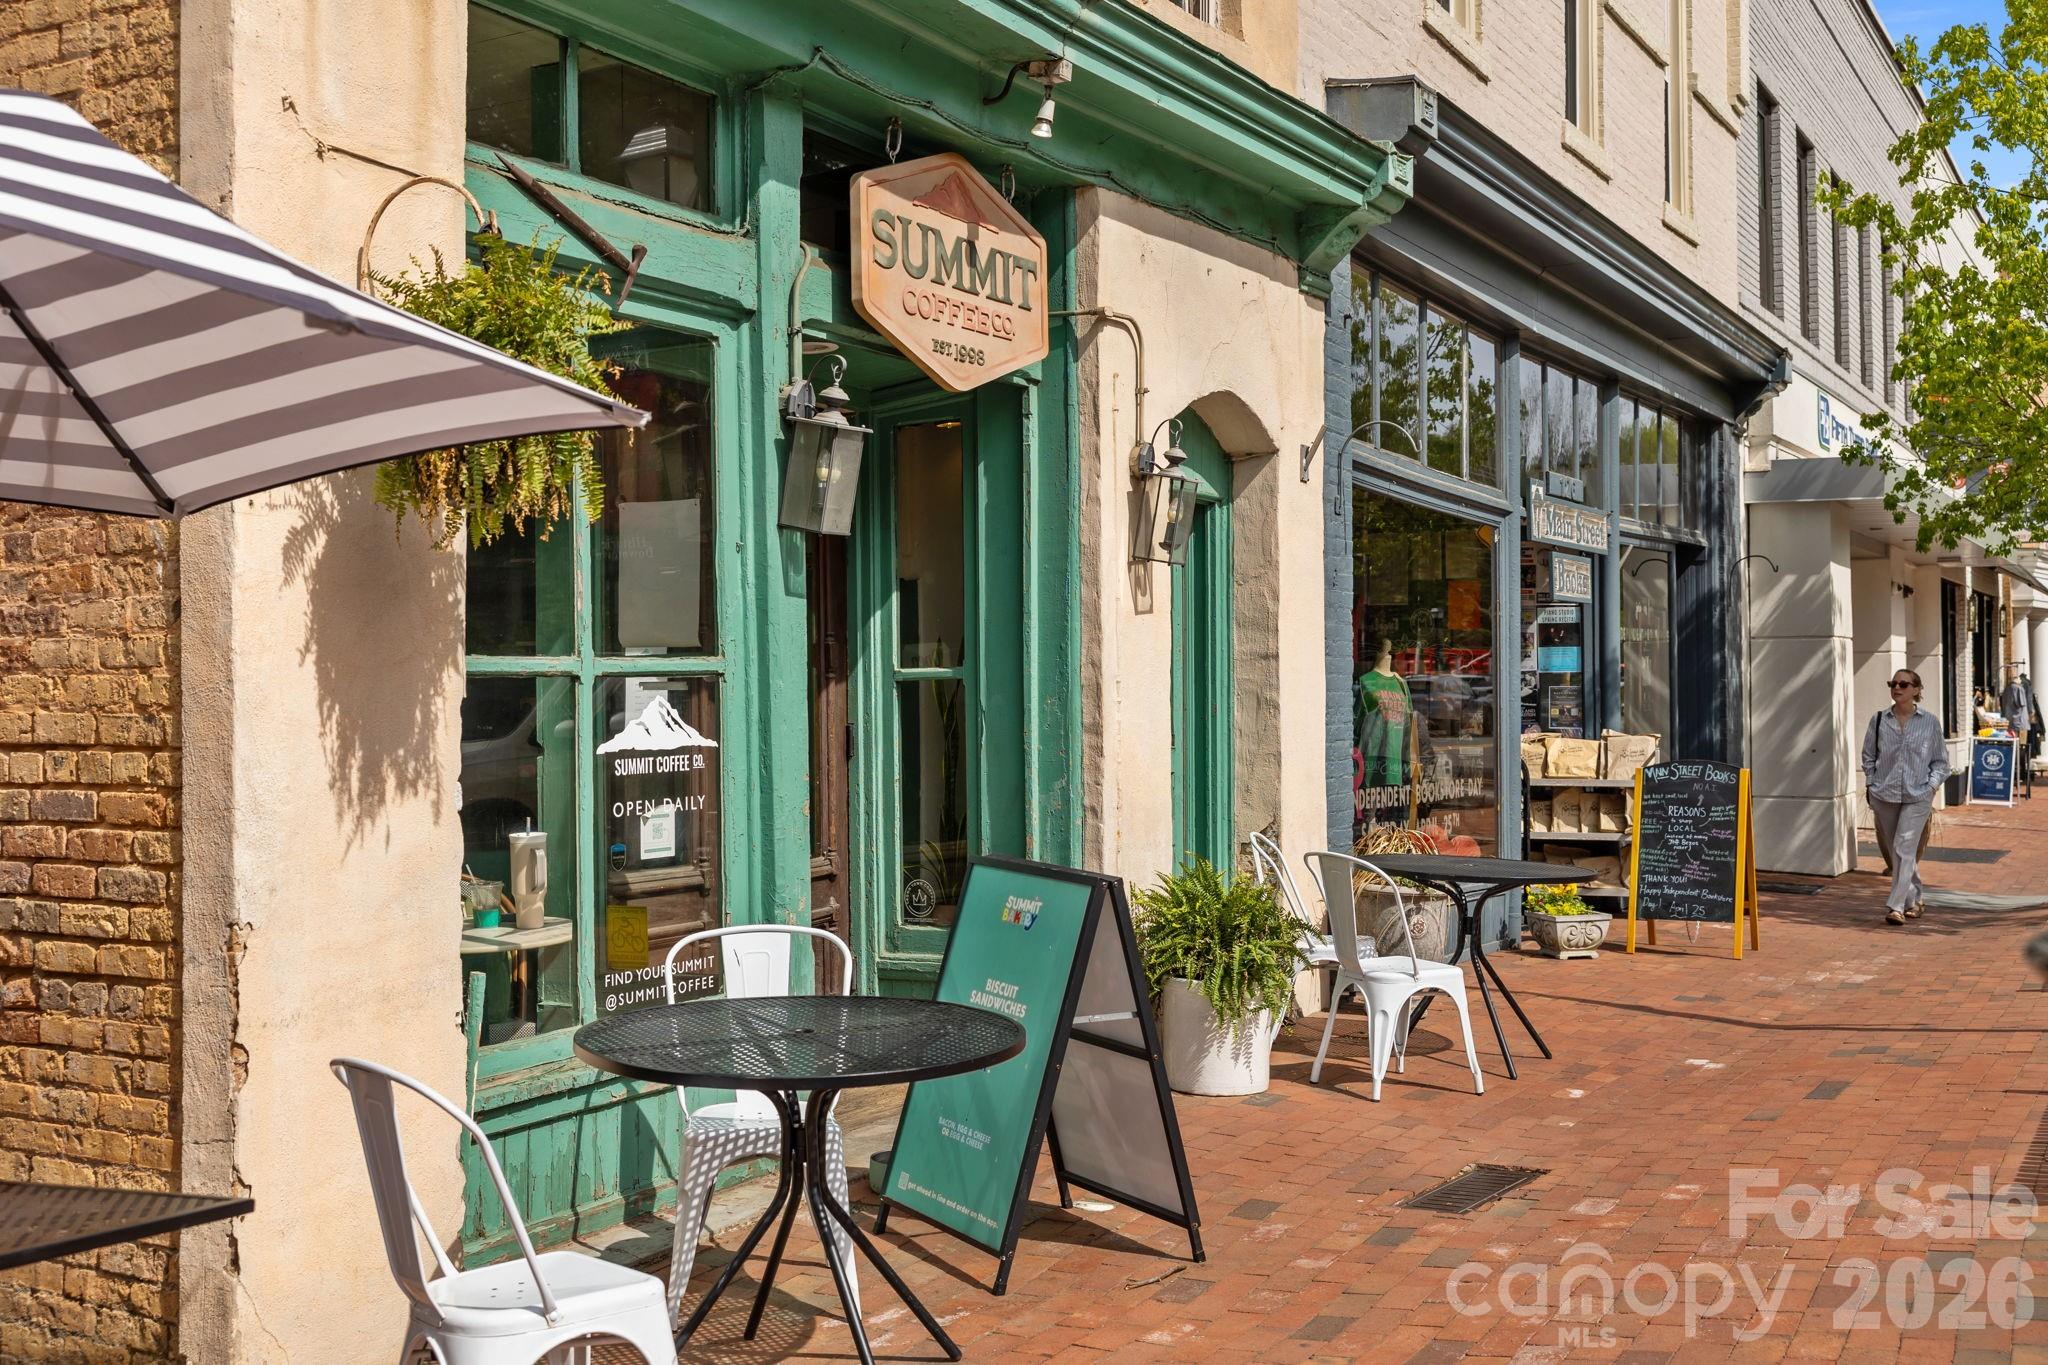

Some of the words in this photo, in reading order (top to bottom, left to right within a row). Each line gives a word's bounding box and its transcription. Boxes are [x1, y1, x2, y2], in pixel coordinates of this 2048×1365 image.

[872, 208, 1037, 312] SUMMIT
[902, 285, 990, 336] COFFEE
[991, 312, 1015, 341] CO.
[954, 345, 985, 367] 1998
[1545, 504, 1573, 540] Main
[1574, 511, 1605, 547] Street
[1554, 558, 1588, 595] Books
[614, 757, 654, 776] SUMMIT
[656, 755, 690, 773] COFFEE
[692, 754, 705, 768] CO.
[1644, 767, 1670, 783] MAIN
[1670, 763, 1703, 780] STREET
[1704, 764, 1737, 784] BOOKS
[1354, 784, 1411, 811] NDEPENDENT
[1416, 778, 1465, 804] BOOKSTORE
[1468, 777, 1483, 796] DAY
[613, 799, 656, 817] OPEN
[663, 795, 706, 812] DAILY
[1668, 806, 1706, 818] REASONS
[1640, 884, 1662, 897] Happy
[1642, 874, 1669, 883] THANK
[1670, 875, 1688, 884] YOU!
[1006, 895, 1043, 914] SUMMIT
[604, 971, 633, 988] FIND
[635, 965, 667, 981] YOUR
[671, 955, 715, 975] SUMMIT
[605, 976, 714, 1011] @SUMMITCOFFEE
[985, 978, 1019, 999] BISCUIT
[970, 990, 1027, 1018] SANDWICHES
[941, 1127, 949, 1137] OR
[965, 1136, 984, 1151] CHEESE
[973, 1130, 992, 1144] CHEESE
[907, 1182, 917, 1190] get
[916, 1184, 932, 1197] ahead
[936, 1193, 946, 1205] line
[946, 1199, 957, 1210] and
[956, 1202, 970, 1216] order
[977, 1212, 987, 1223] the
